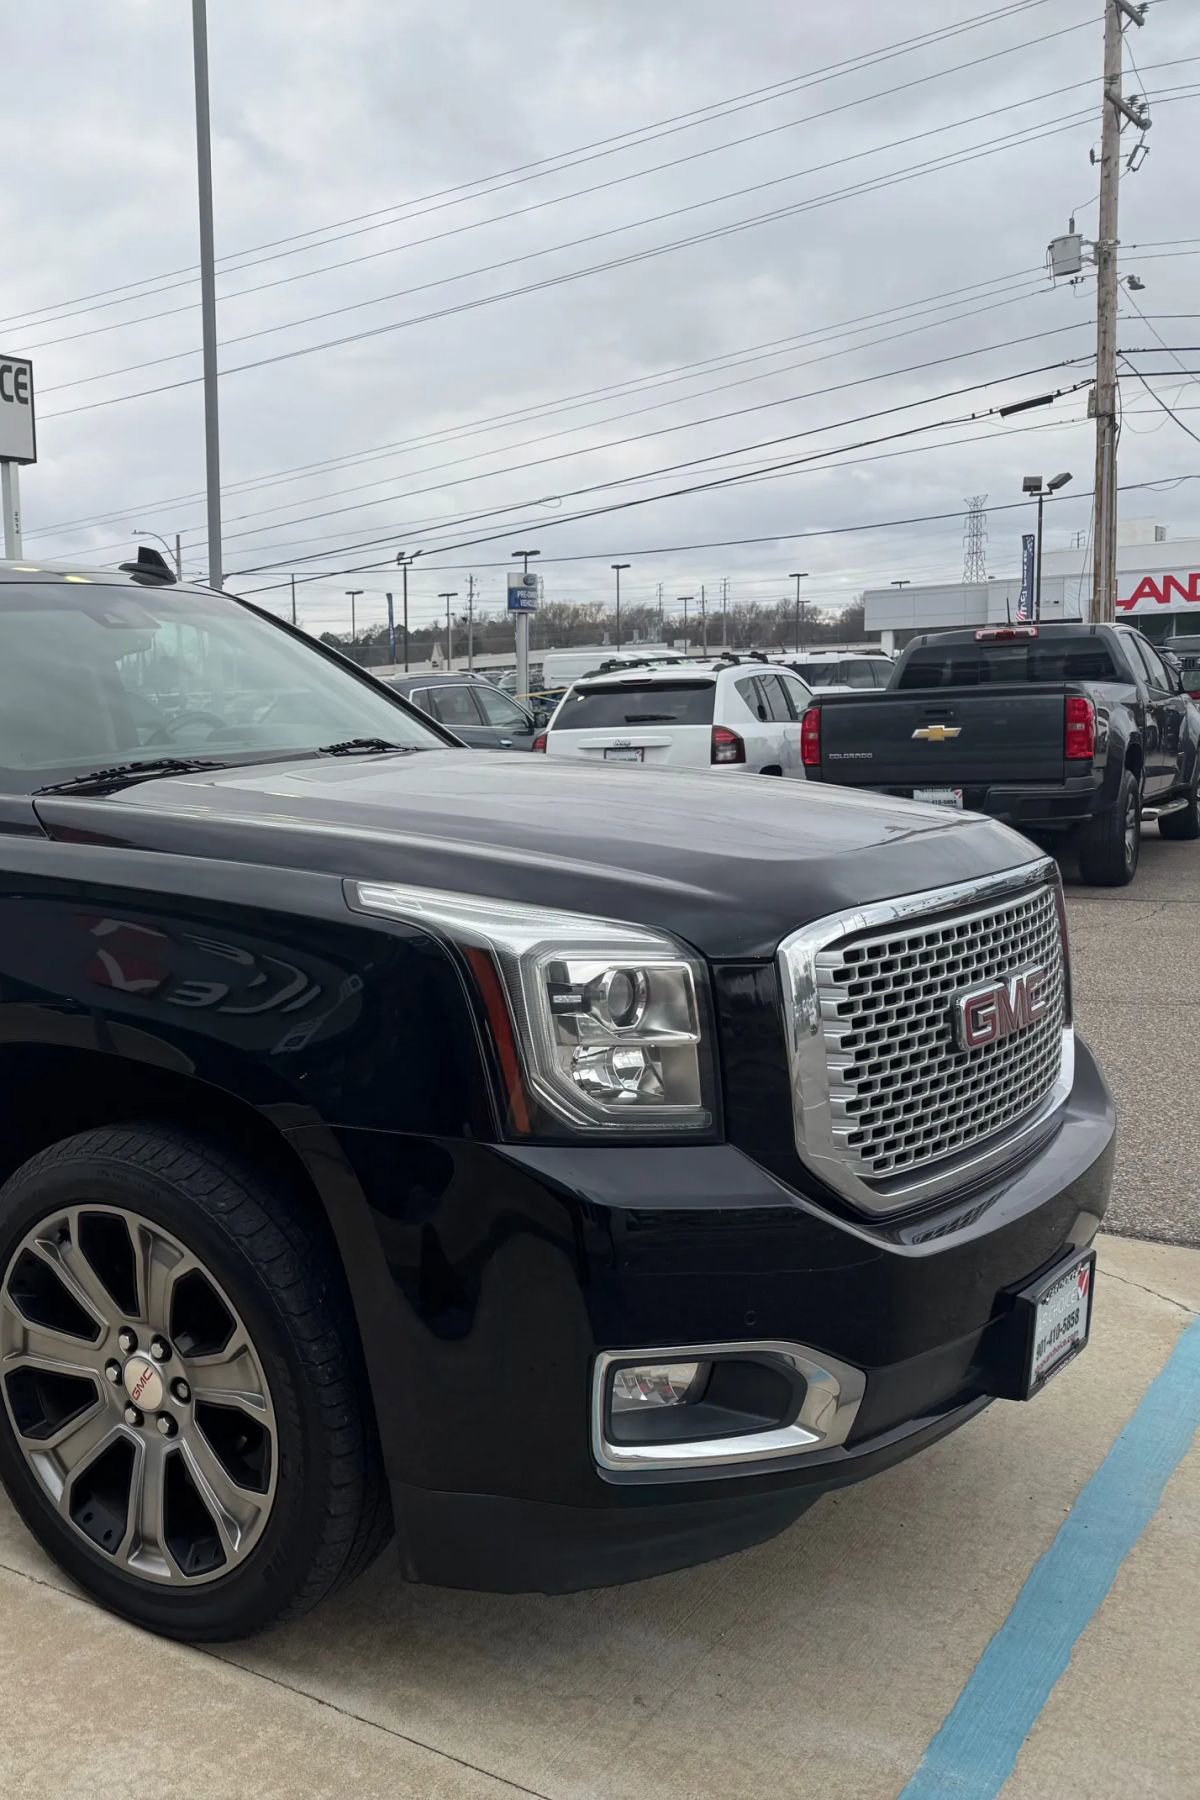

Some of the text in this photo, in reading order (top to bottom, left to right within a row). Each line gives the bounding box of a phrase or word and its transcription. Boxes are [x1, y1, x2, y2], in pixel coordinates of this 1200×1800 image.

[828, 752, 873, 760] COLORADO
[958, 964, 1047, 1051] GMC
[1036, 1307, 1080, 1361] 901-410-5858
[131, 1367, 154, 1401] GMC
